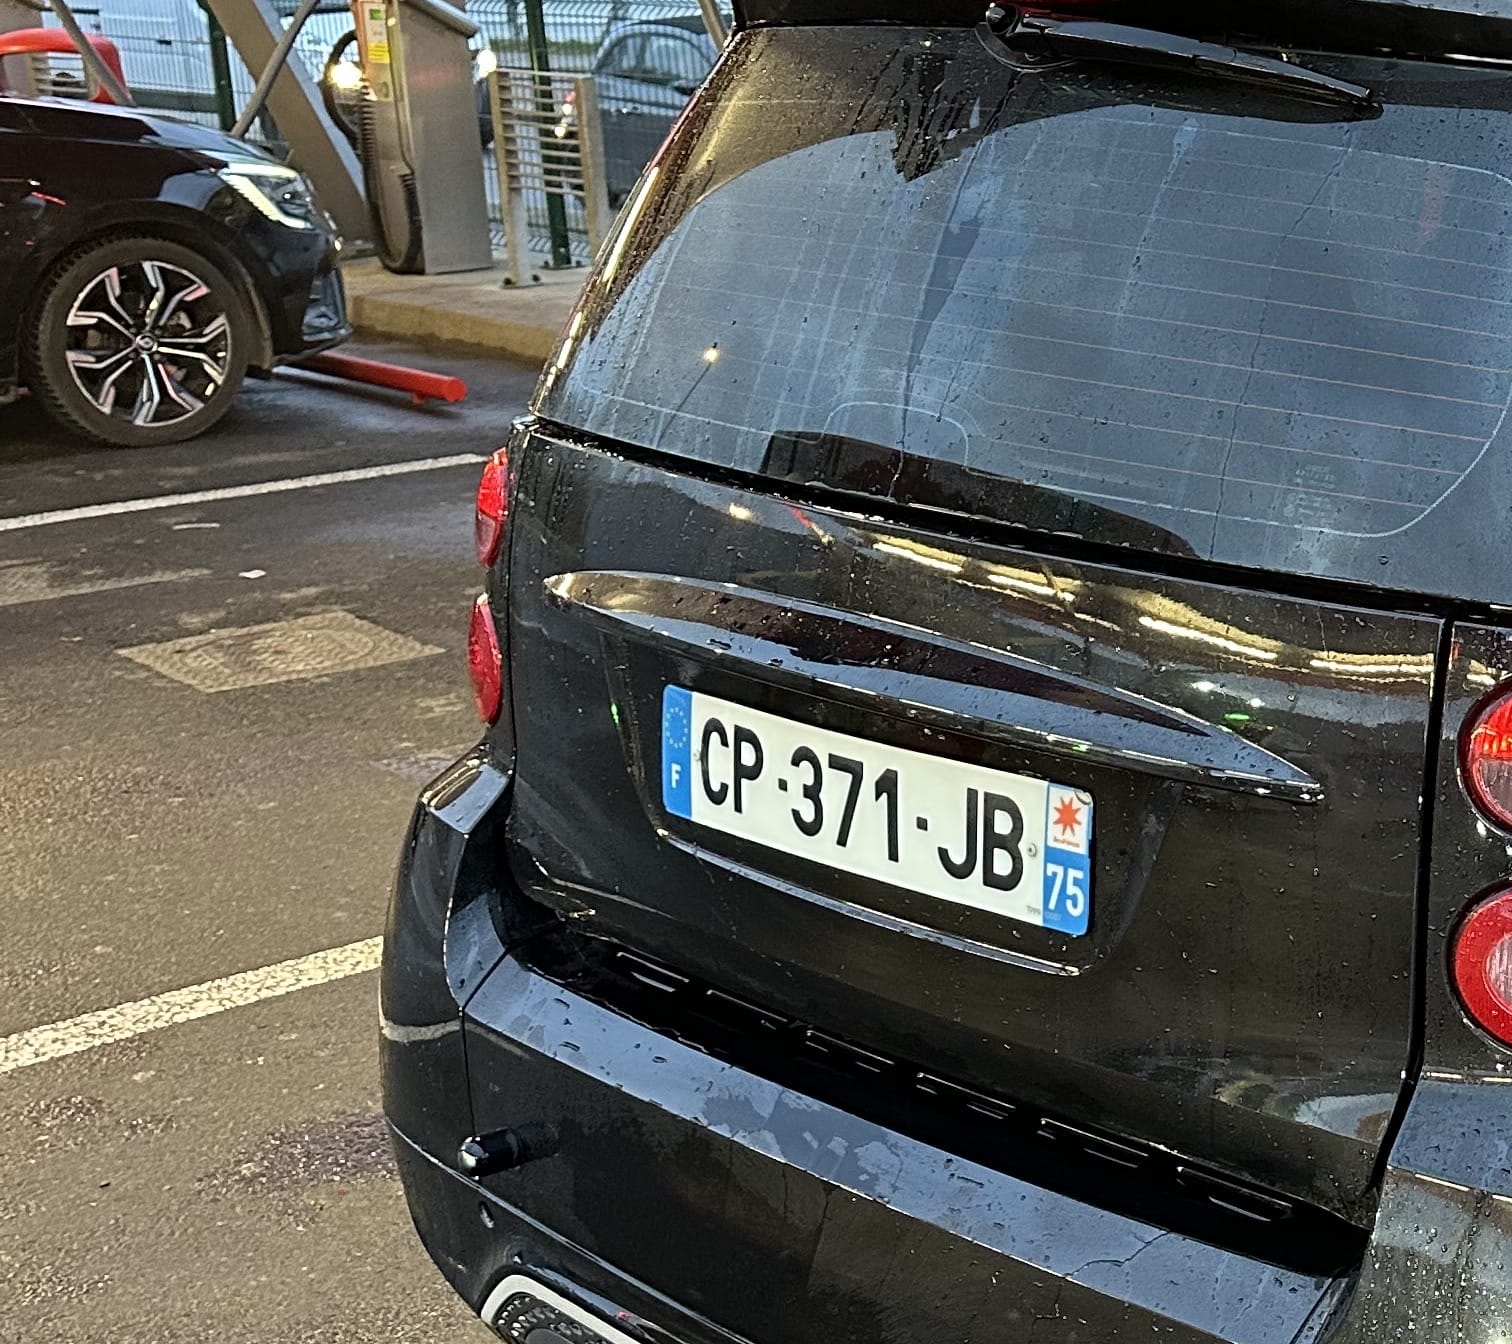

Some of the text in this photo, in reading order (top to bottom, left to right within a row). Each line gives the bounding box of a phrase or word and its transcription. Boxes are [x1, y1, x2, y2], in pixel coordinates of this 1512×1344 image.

[671, 764, 682, 789] F
[701, 717, 1024, 892] CP-371-JB
[1046, 862, 1084, 917] 75
